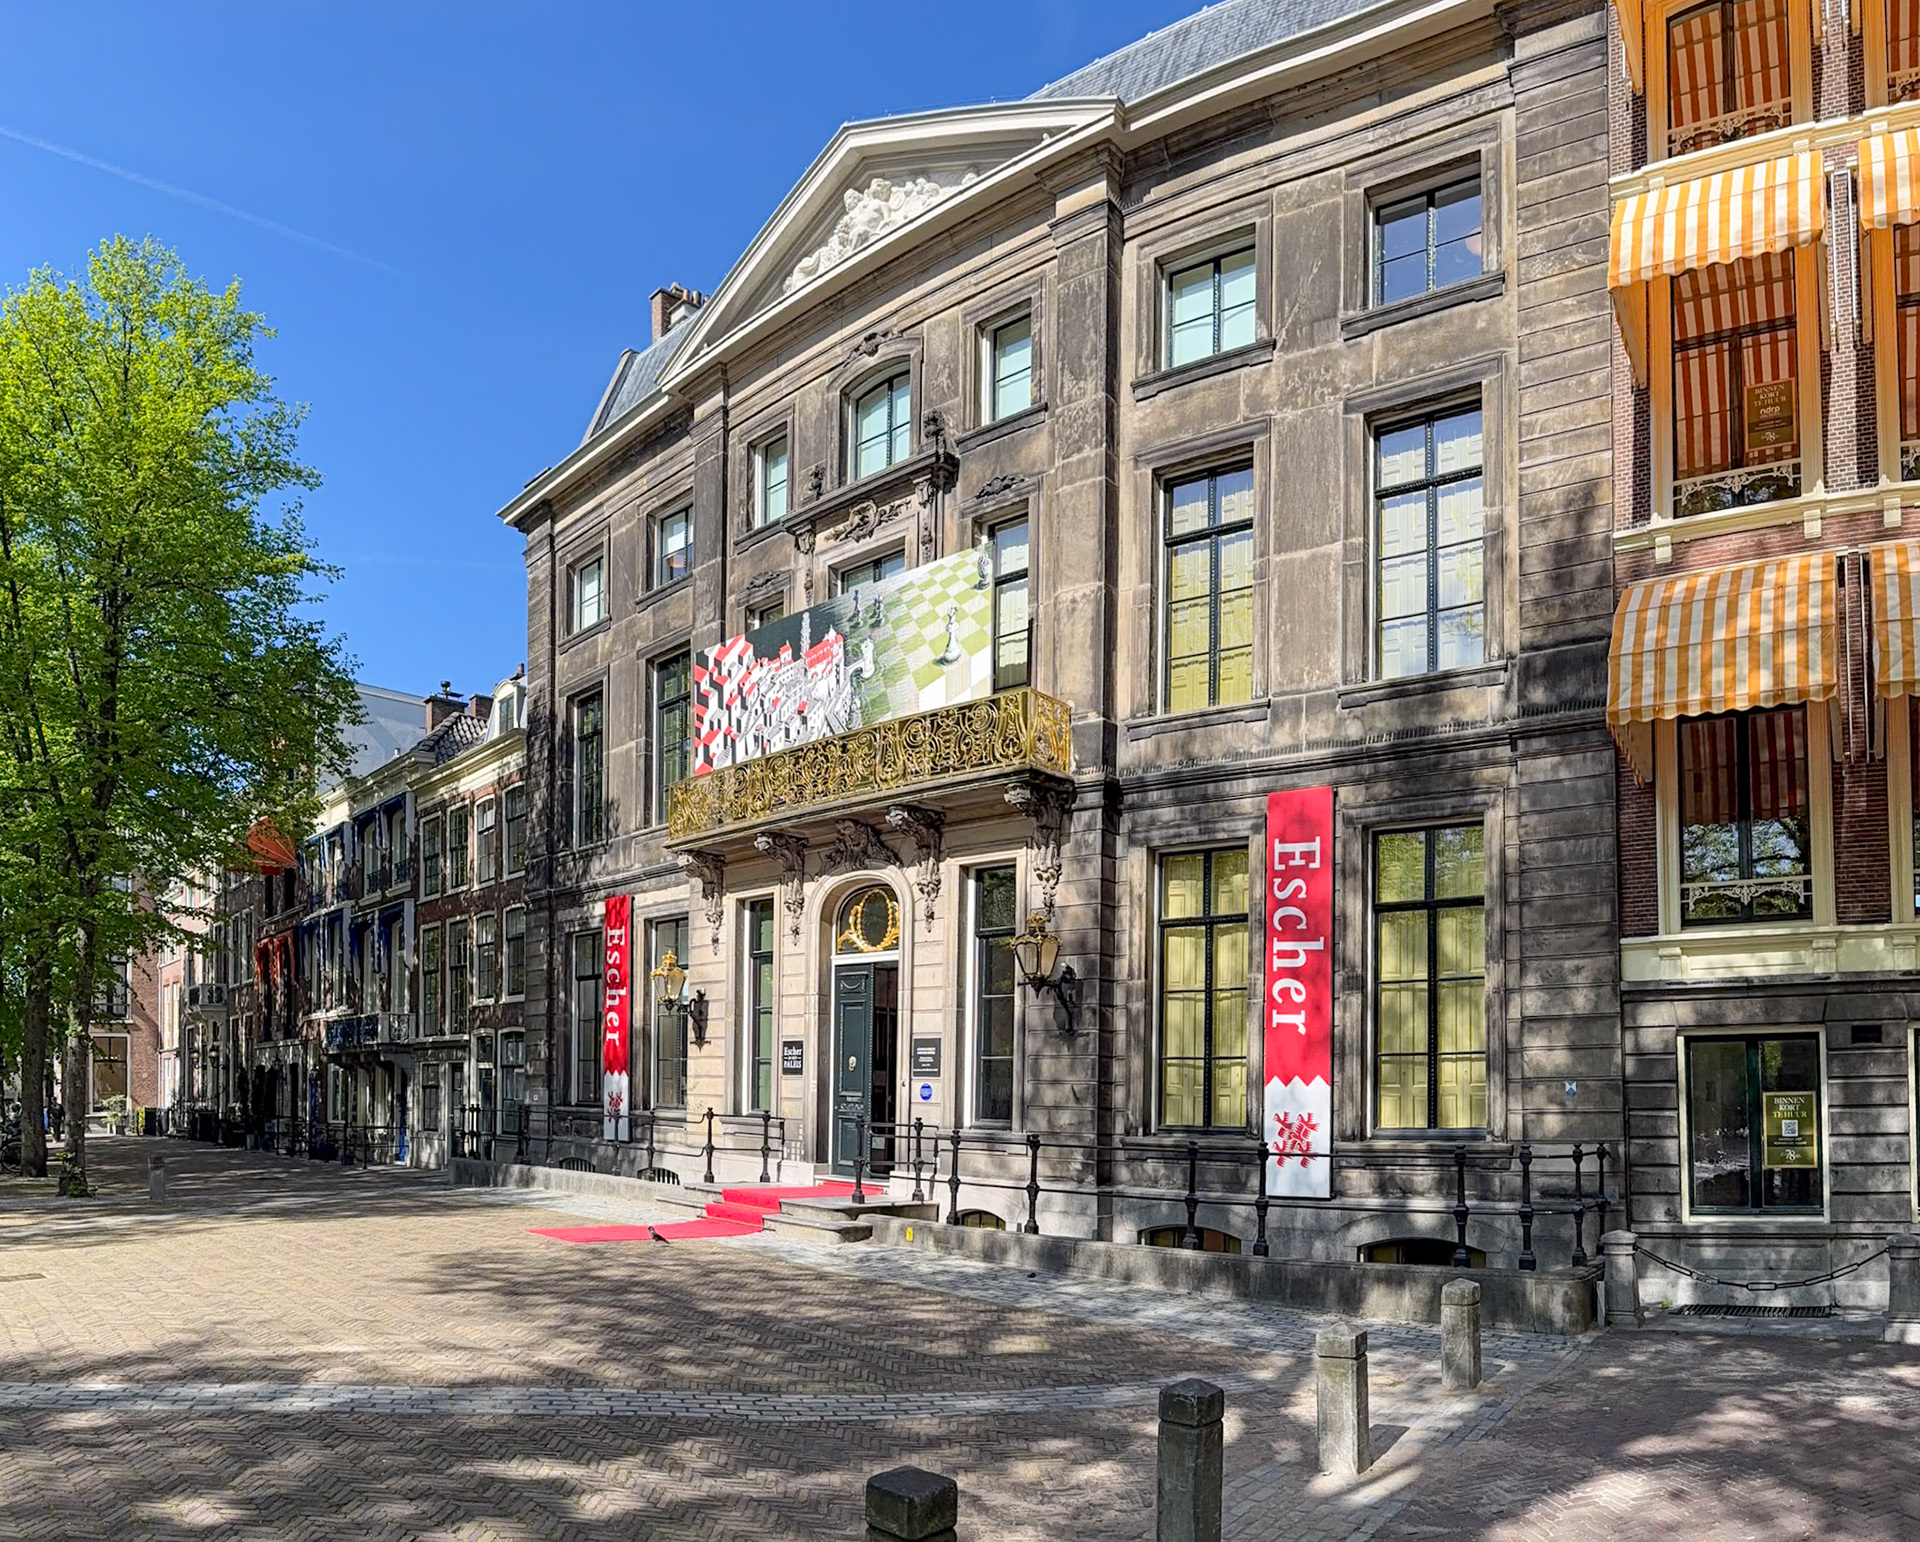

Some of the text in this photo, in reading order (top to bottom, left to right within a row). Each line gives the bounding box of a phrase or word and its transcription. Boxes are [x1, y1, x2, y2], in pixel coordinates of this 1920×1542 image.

[1760, 405, 1780, 415] ndrp
[1765, 431, 1776, 442] 78
[1272, 836, 1325, 1035] Escher
[606, 925, 627, 1046] Escher
[783, 1046, 802, 1056] Escher
[1773, 1097, 1805, 1105] BINNEN
[1785, 1149, 1796, 1161] 78
